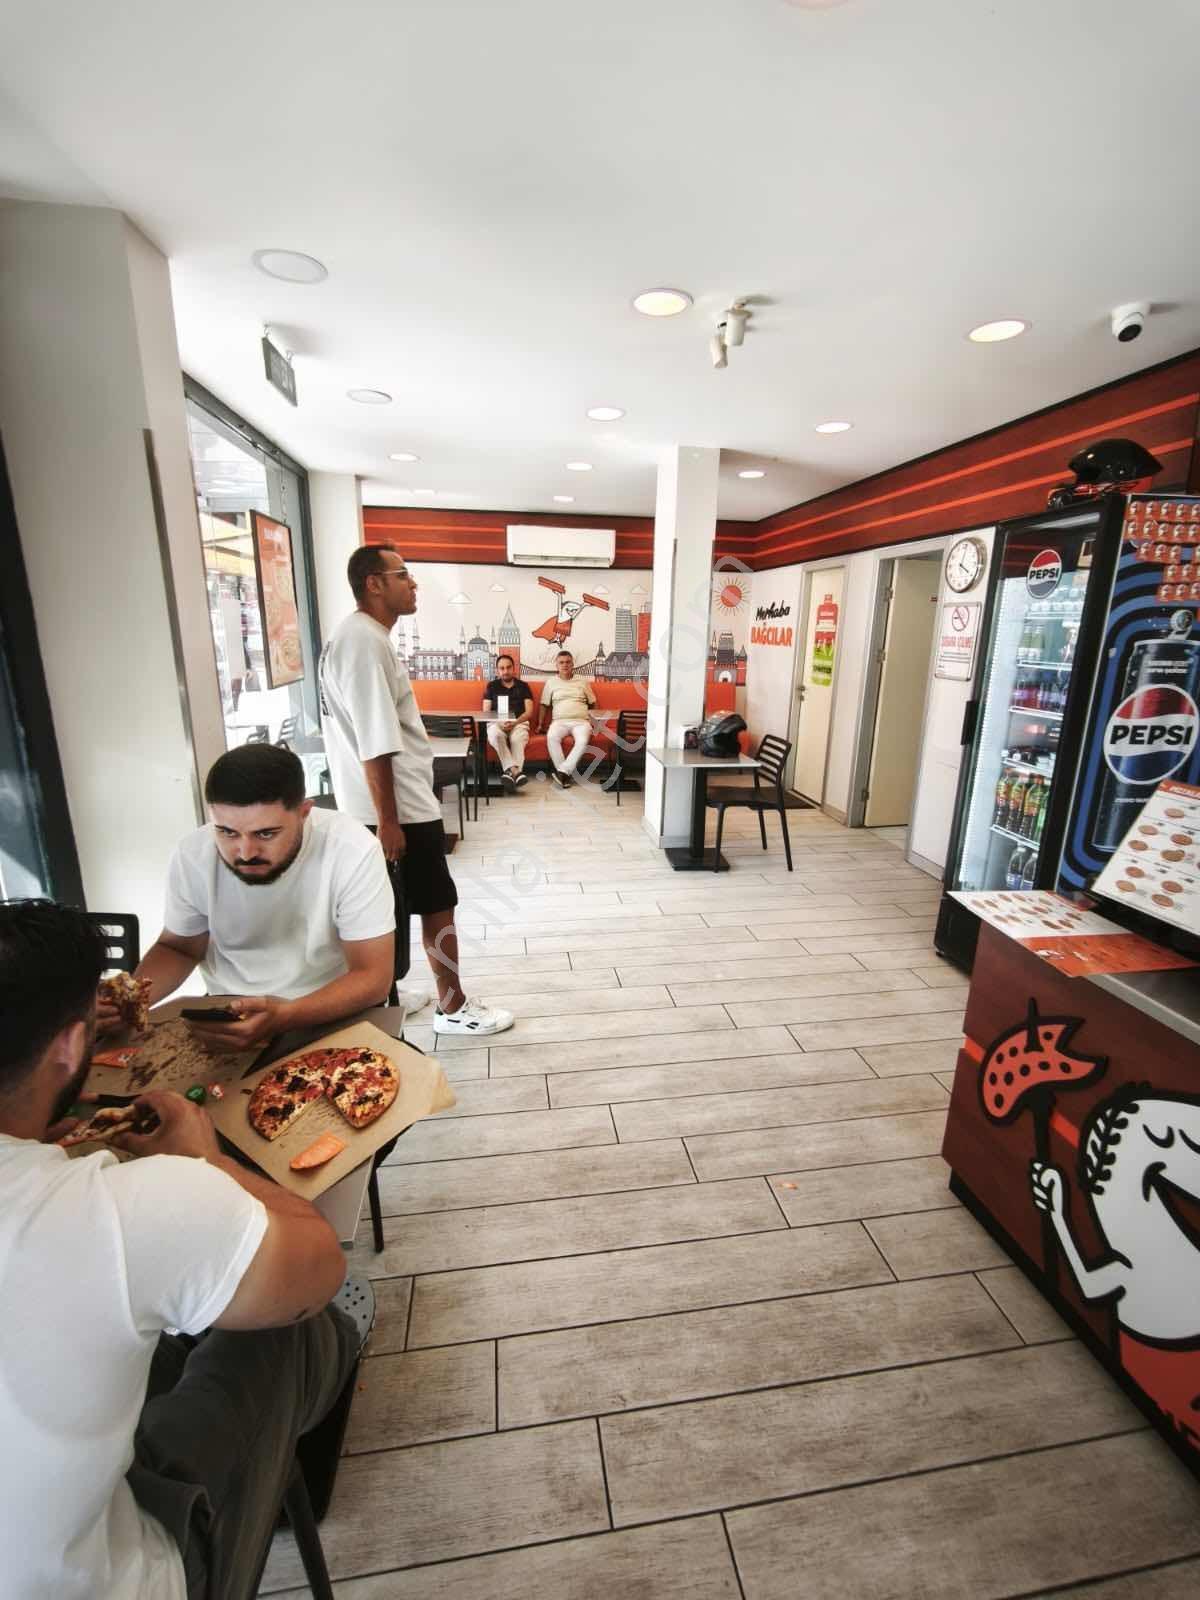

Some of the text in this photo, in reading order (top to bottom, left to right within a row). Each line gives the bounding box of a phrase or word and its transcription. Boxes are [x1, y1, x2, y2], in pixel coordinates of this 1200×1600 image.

[1029, 567, 1060, 580] PEPSI
[756, 600, 791, 621] Merhaba
[1110, 725, 1193, 745] PEPSI
